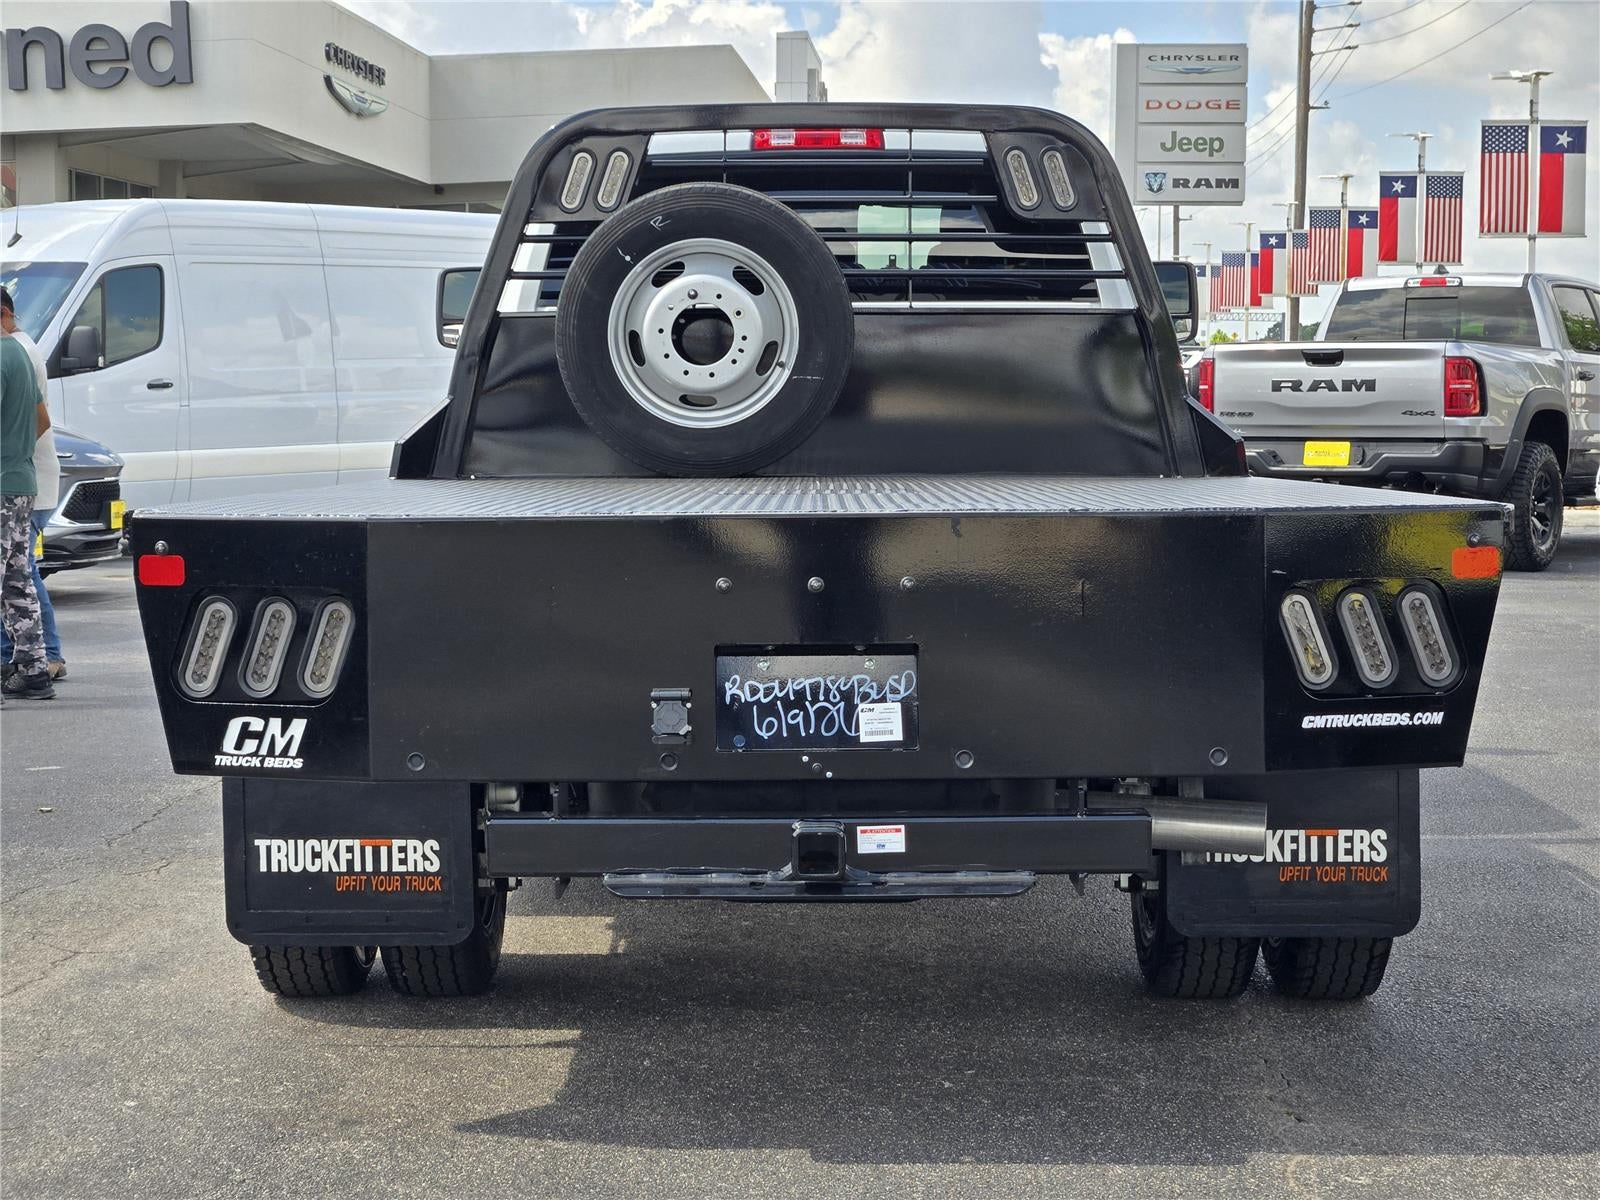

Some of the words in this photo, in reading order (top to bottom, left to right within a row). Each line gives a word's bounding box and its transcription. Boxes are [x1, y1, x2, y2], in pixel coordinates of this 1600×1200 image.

[0, 0, 194, 91] ned
[324, 42, 386, 86] CHRYSLER
[1145, 99, 1241, 110] DODGE
[1160, 130, 1225, 157] Jeep
[1172, 178, 1240, 189] RAM
[1271, 378, 1377, 393] RAM
[1301, 711, 1445, 729] CMTRUCKBEDS.COM
[222, 716, 308, 757] CM
[214, 755, 262, 768] TRUCK
[263, 757, 304, 769] BEDS
[1205, 828, 1388, 863] KFITTERS
[254, 838, 441, 873] TRUCKFITTERS
[1279, 866, 1311, 882] UPFIT
[1315, 866, 1346, 882] YOUR
[1351, 865, 1388, 881] TRUCK
[335, 876, 367, 892] UPFIT
[371, 875, 400, 892] YOUR
[405, 875, 442, 892] TRUCK
